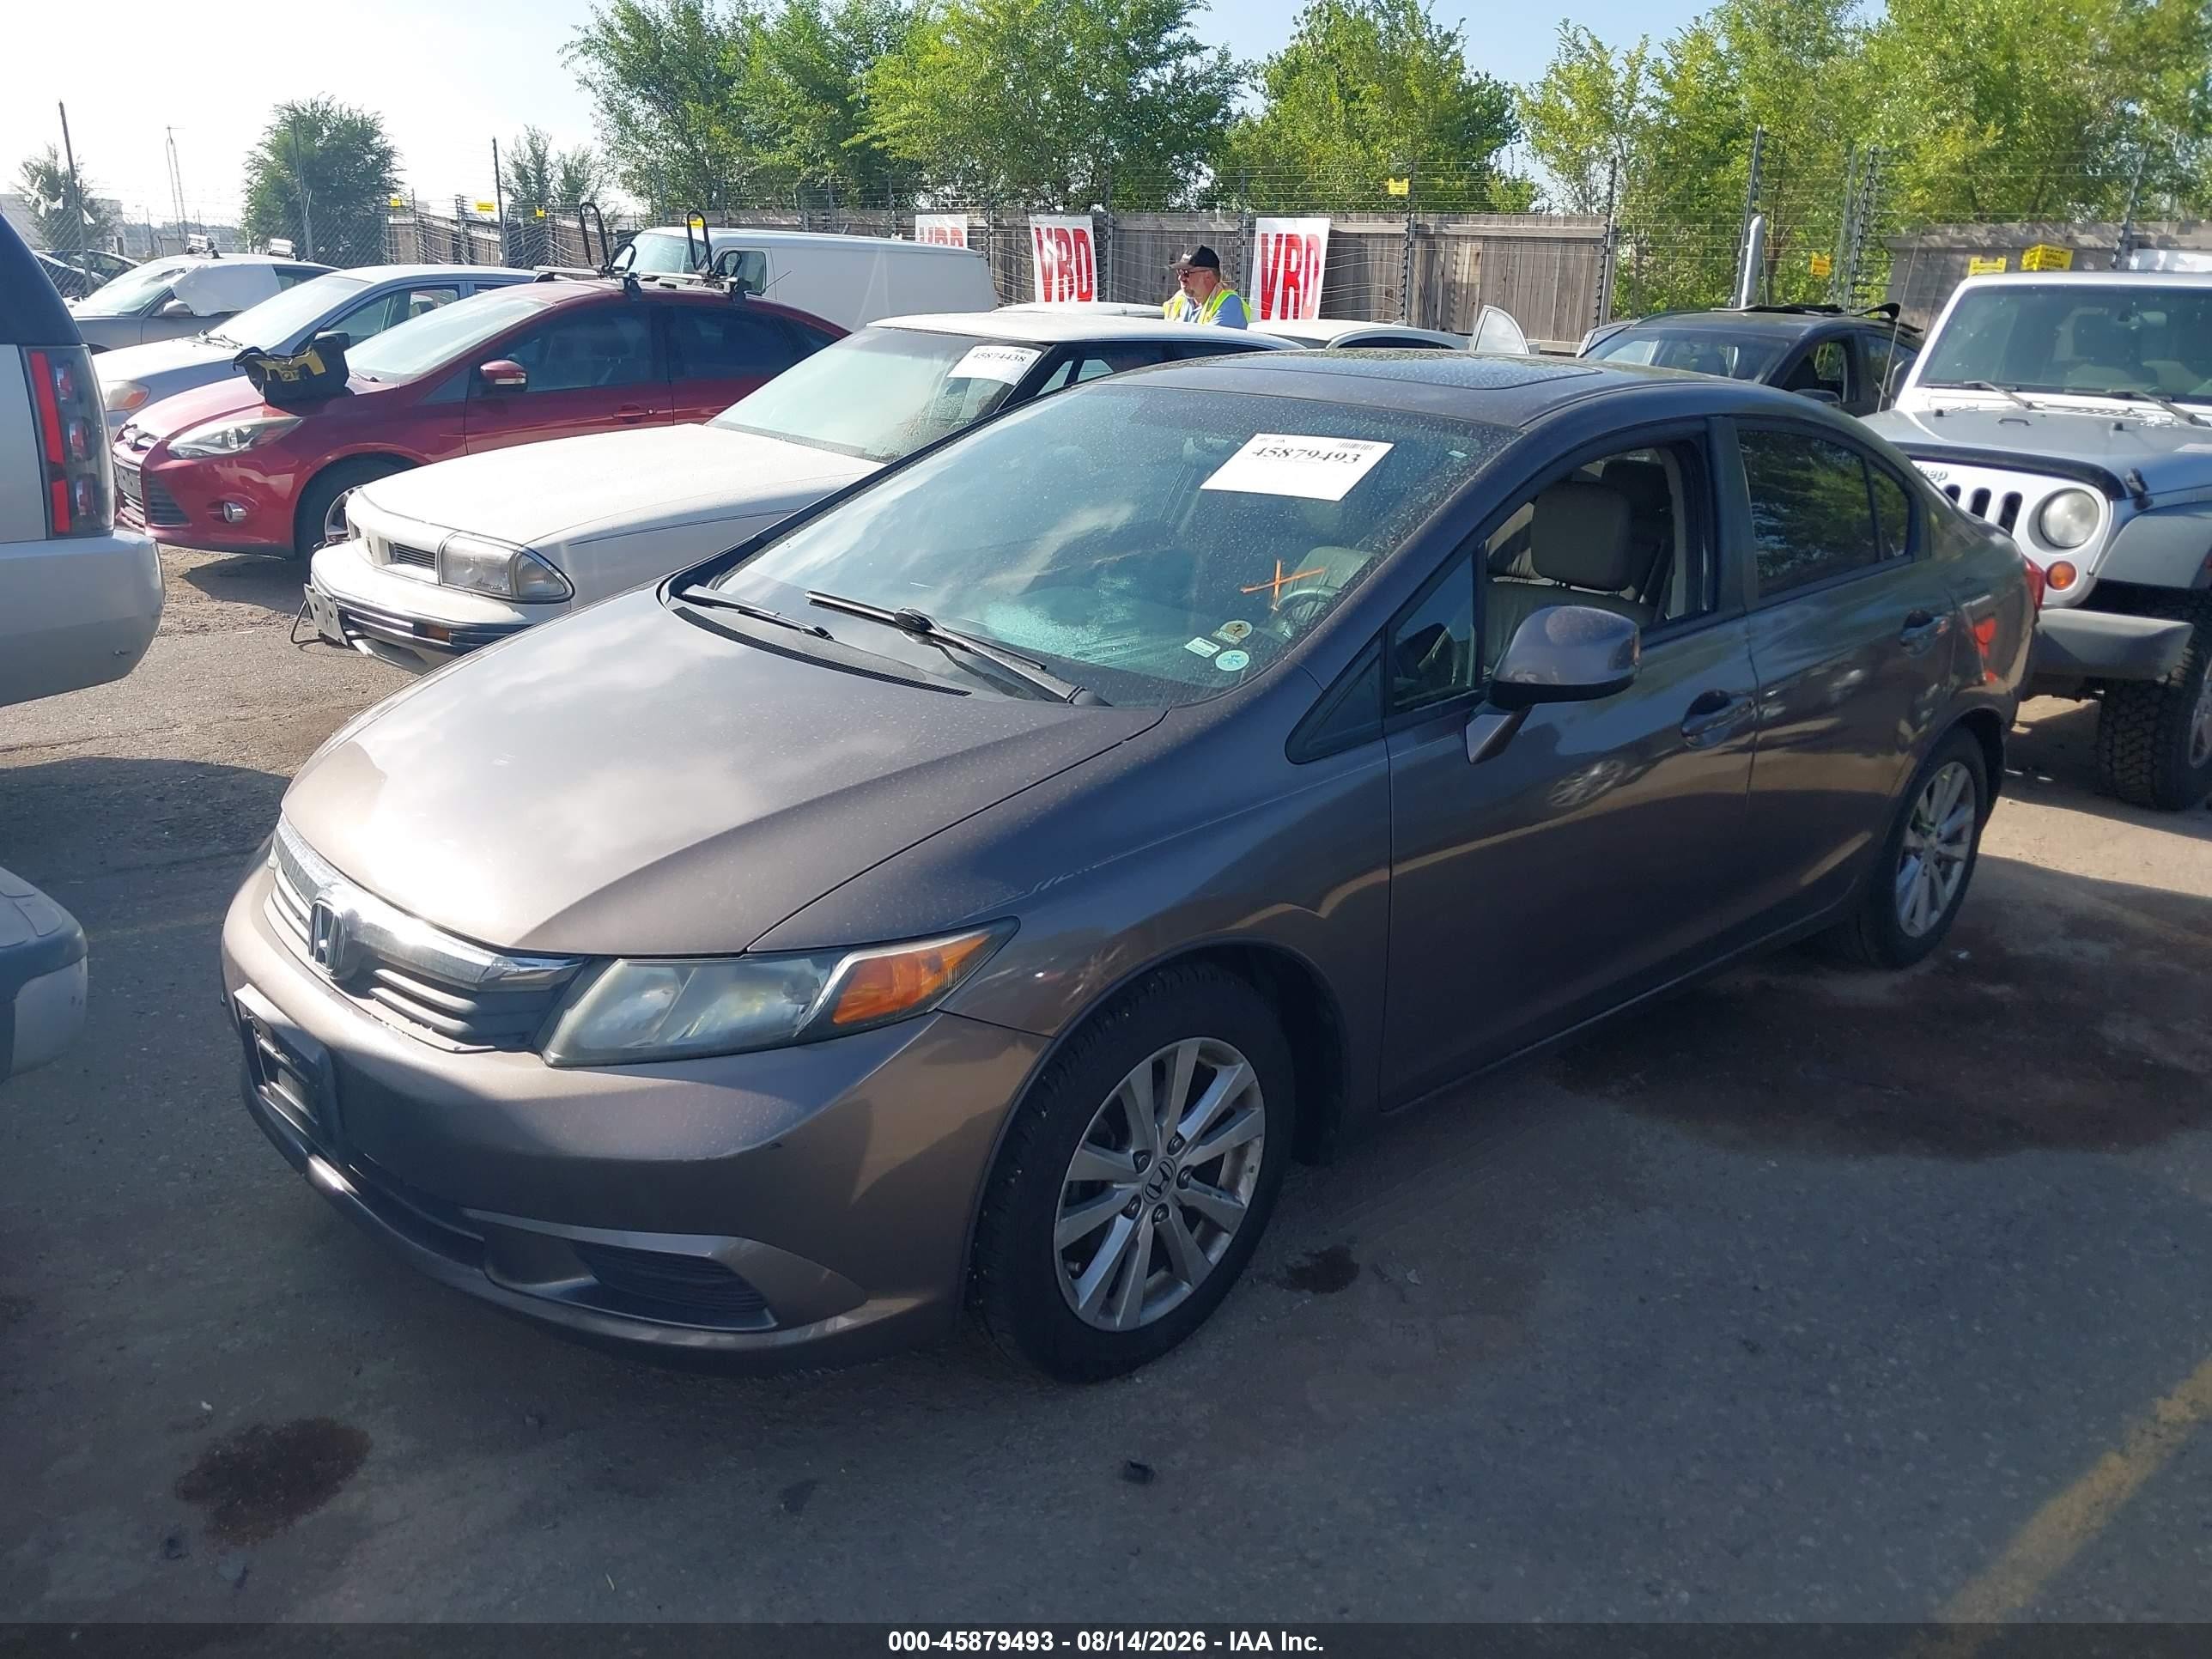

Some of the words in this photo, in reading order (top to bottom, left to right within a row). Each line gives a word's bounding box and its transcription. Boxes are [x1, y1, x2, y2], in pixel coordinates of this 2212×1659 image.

[1035, 227, 1093, 302] VRD
[1260, 233, 1321, 320] VRD
[1252, 447, 1361, 464] 45879493
